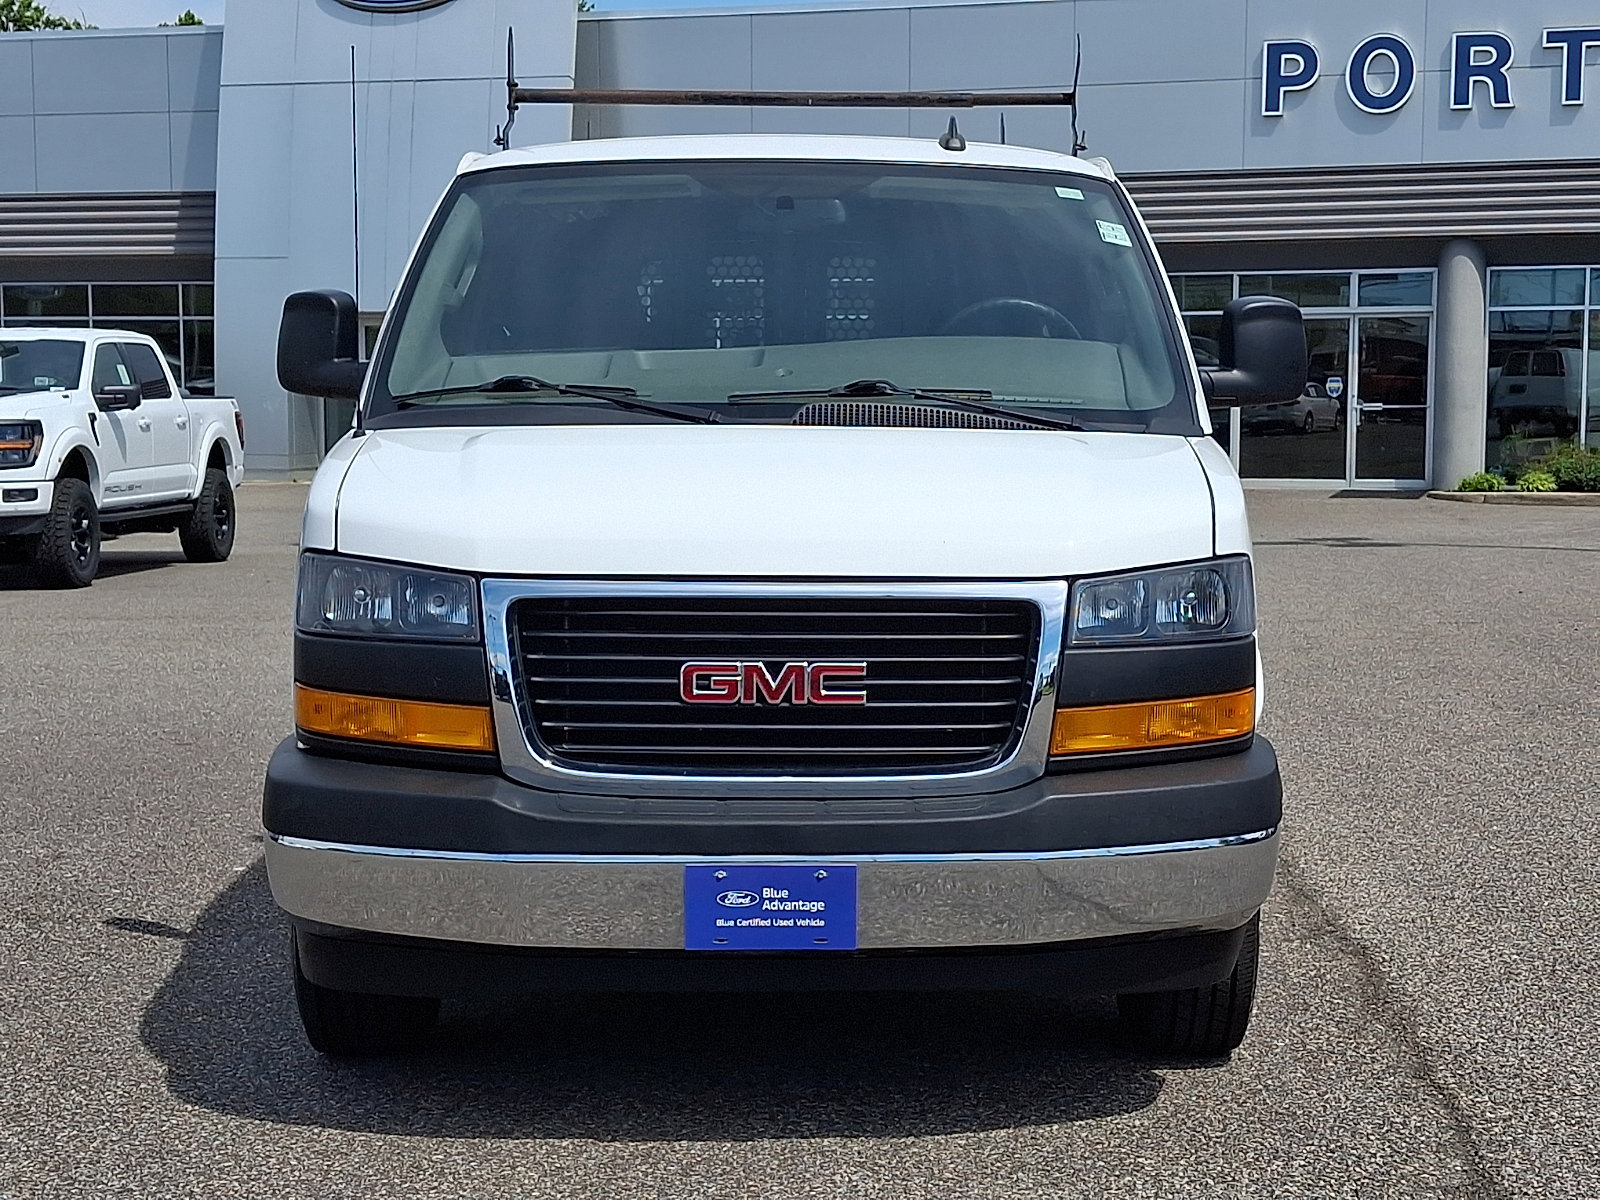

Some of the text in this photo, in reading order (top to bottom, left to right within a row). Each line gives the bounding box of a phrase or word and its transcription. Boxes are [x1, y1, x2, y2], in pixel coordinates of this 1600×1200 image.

[1261, 27, 1600, 116] PORT
[104, 484, 142, 493] ROUSH
[680, 661, 867, 704] GMC
[723, 892, 753, 905] Ford
[762, 887, 789, 899] Blue
[762, 899, 825, 913] Advantage
[716, 918, 825, 927] Blue Certified Used Vehicle
